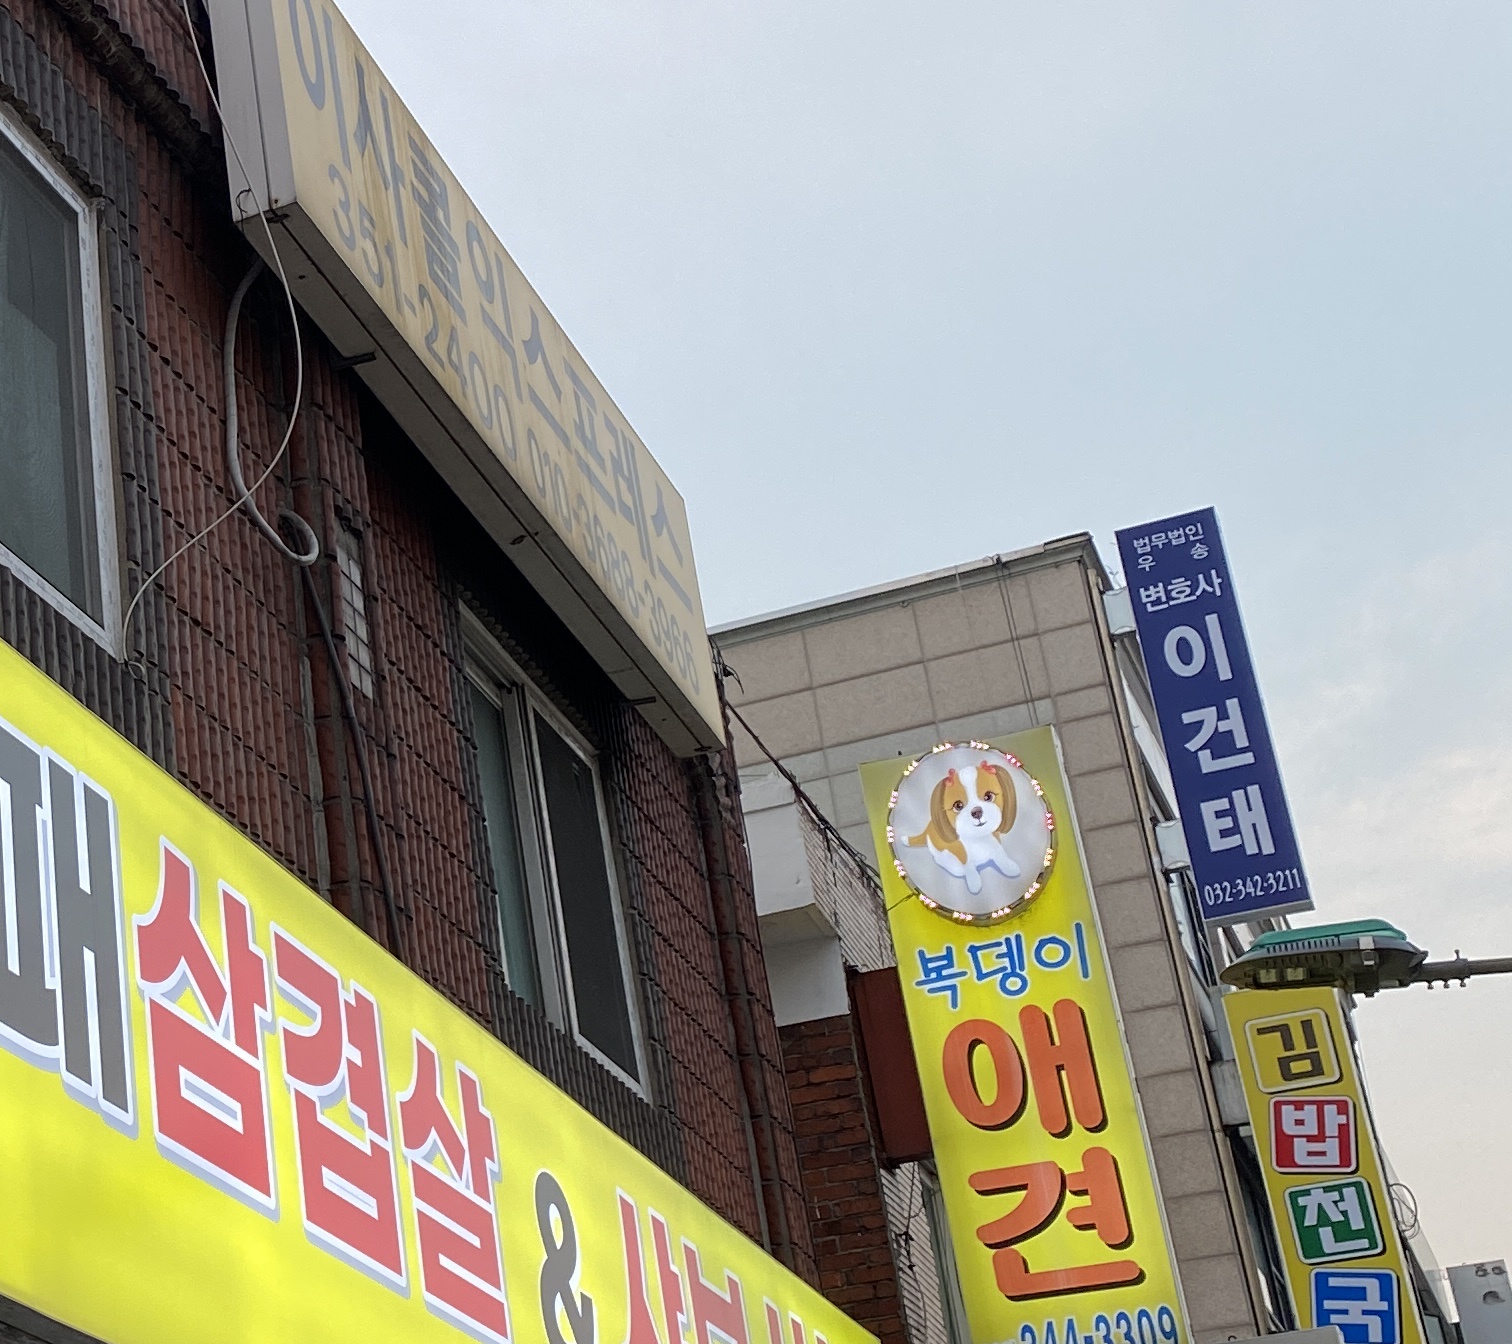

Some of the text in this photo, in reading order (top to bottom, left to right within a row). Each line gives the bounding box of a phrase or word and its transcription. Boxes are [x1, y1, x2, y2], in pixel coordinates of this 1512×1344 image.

[328, 163, 518, 462] 351-2400
[1132, 523, 1205, 556] 법무법인
[1139, 568, 1224, 613] 변호사
[1163, 613, 1276, 856] 이건태
[914, 921, 1092, 1011] 복뎅이
[1203, 867, 1303, 907] 032-342-3211
[941, 998, 1146, 1302] 애견
[1254, 1017, 1390, 1343] 김밥천국
